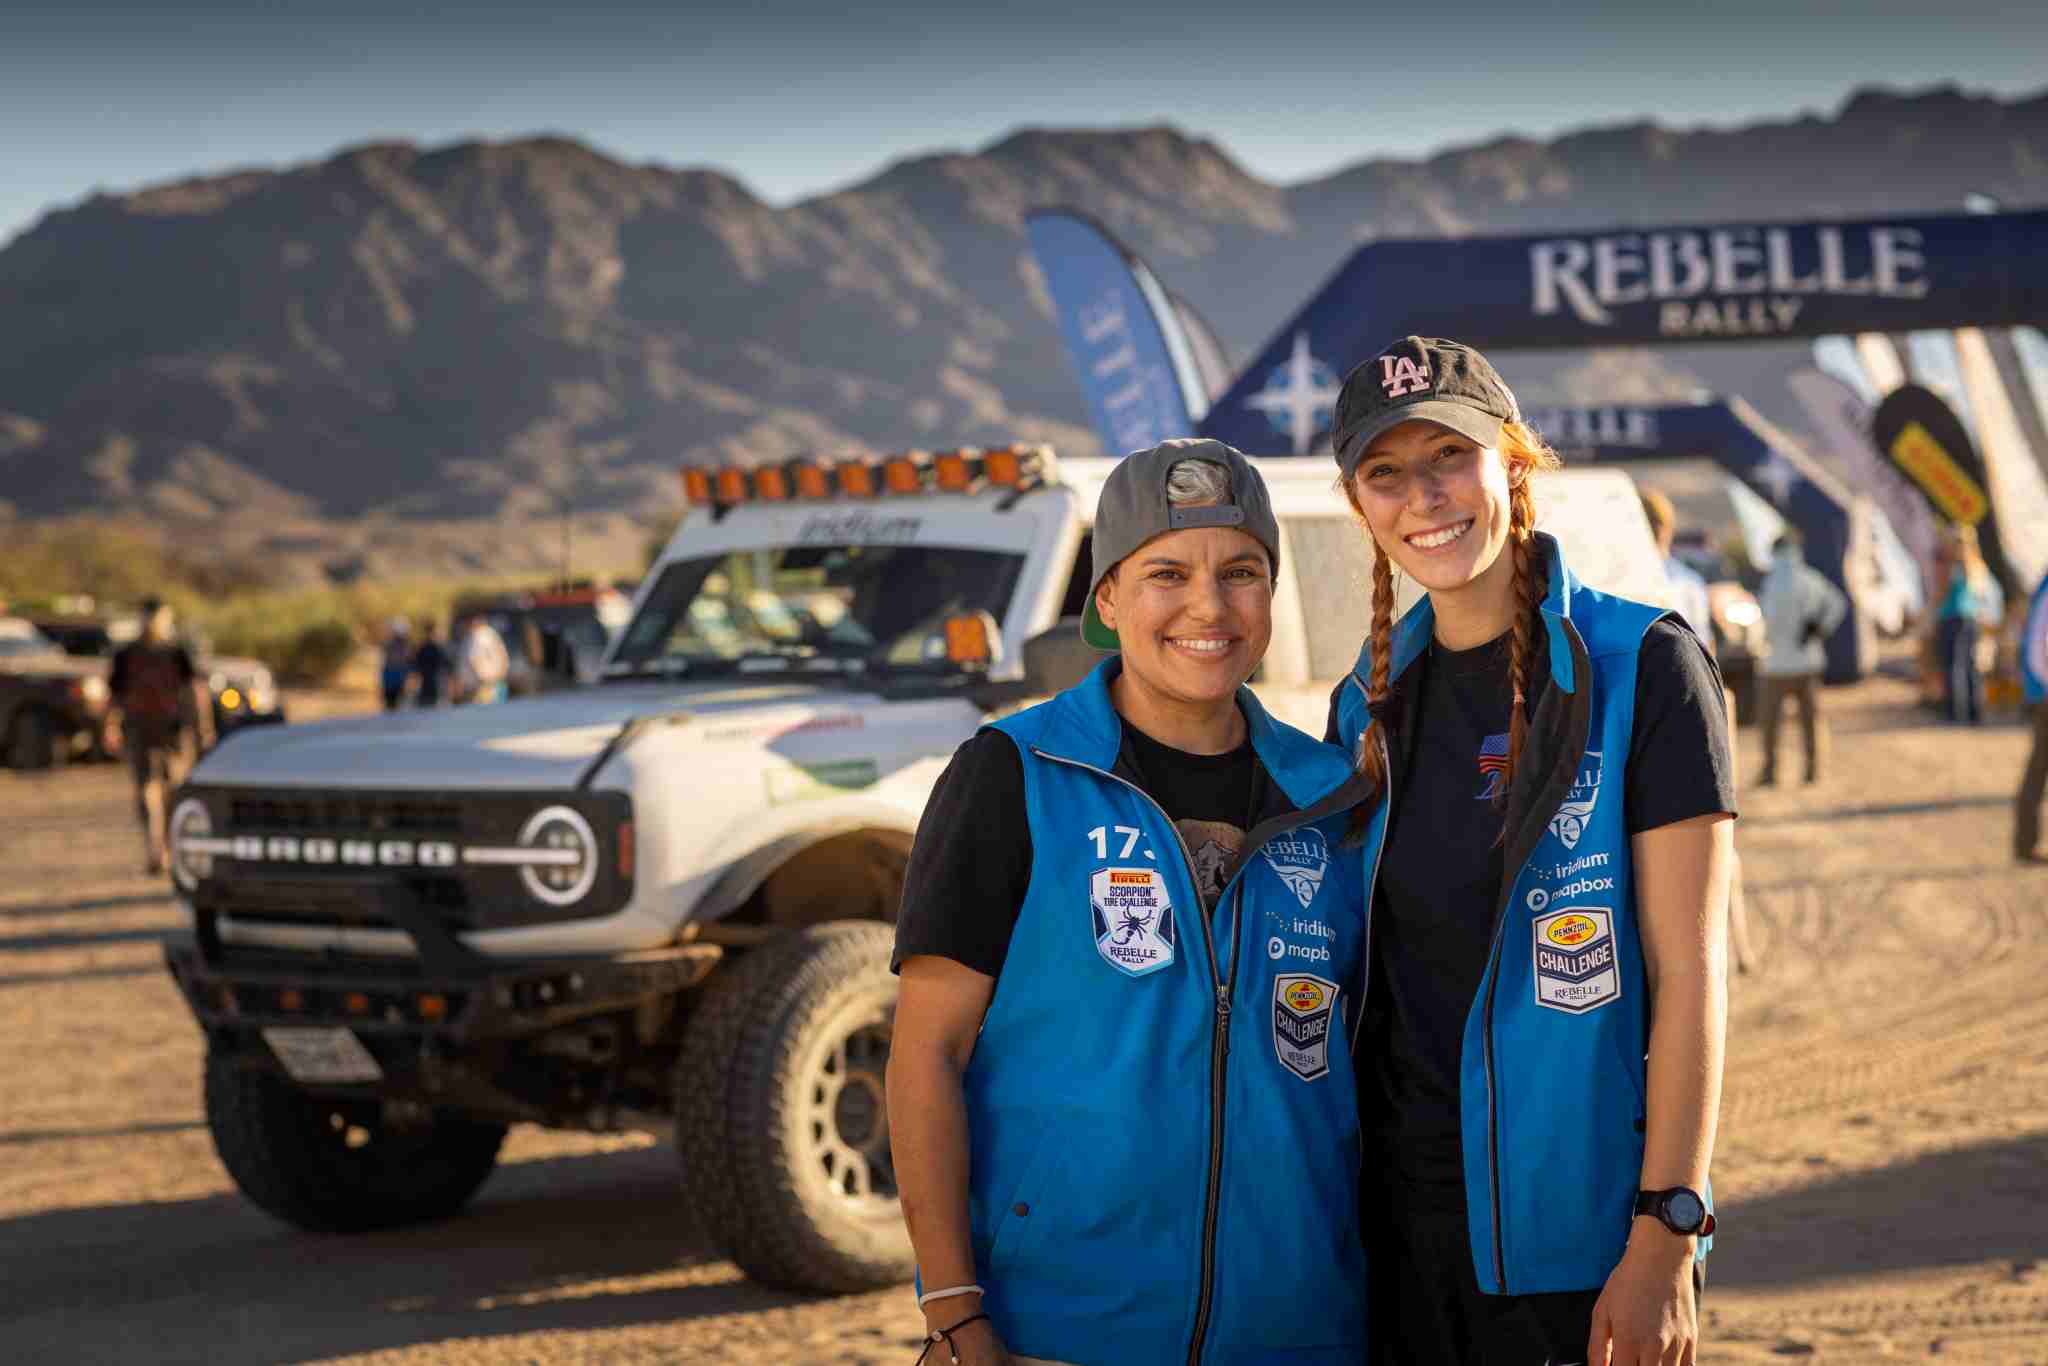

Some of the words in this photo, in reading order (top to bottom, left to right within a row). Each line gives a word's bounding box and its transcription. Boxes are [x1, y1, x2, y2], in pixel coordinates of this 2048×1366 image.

[1530, 226, 1929, 326] REBELLE
[1659, 299, 1804, 336] RALLY
[1378, 355, 1430, 398] LA
[231, 837, 457, 866] BRONCO
[1110, 872, 1151, 884] PIRELLI
[1556, 852, 1609, 879] iridium
[1103, 897, 1119, 907] TIRE
[1120, 897, 1158, 907] CHALLENGE
[1109, 886, 1152, 897] SCORPION
[1552, 876, 1614, 902] mapbox
[1552, 921, 1590, 938] PENNZOIL
[1110, 945, 1157, 960] REBELLE
[1288, 942, 1332, 963] mapb
[1539, 943, 1612, 976] CHALLENGE
[1276, 1010, 1327, 1042] CHALLENGE
